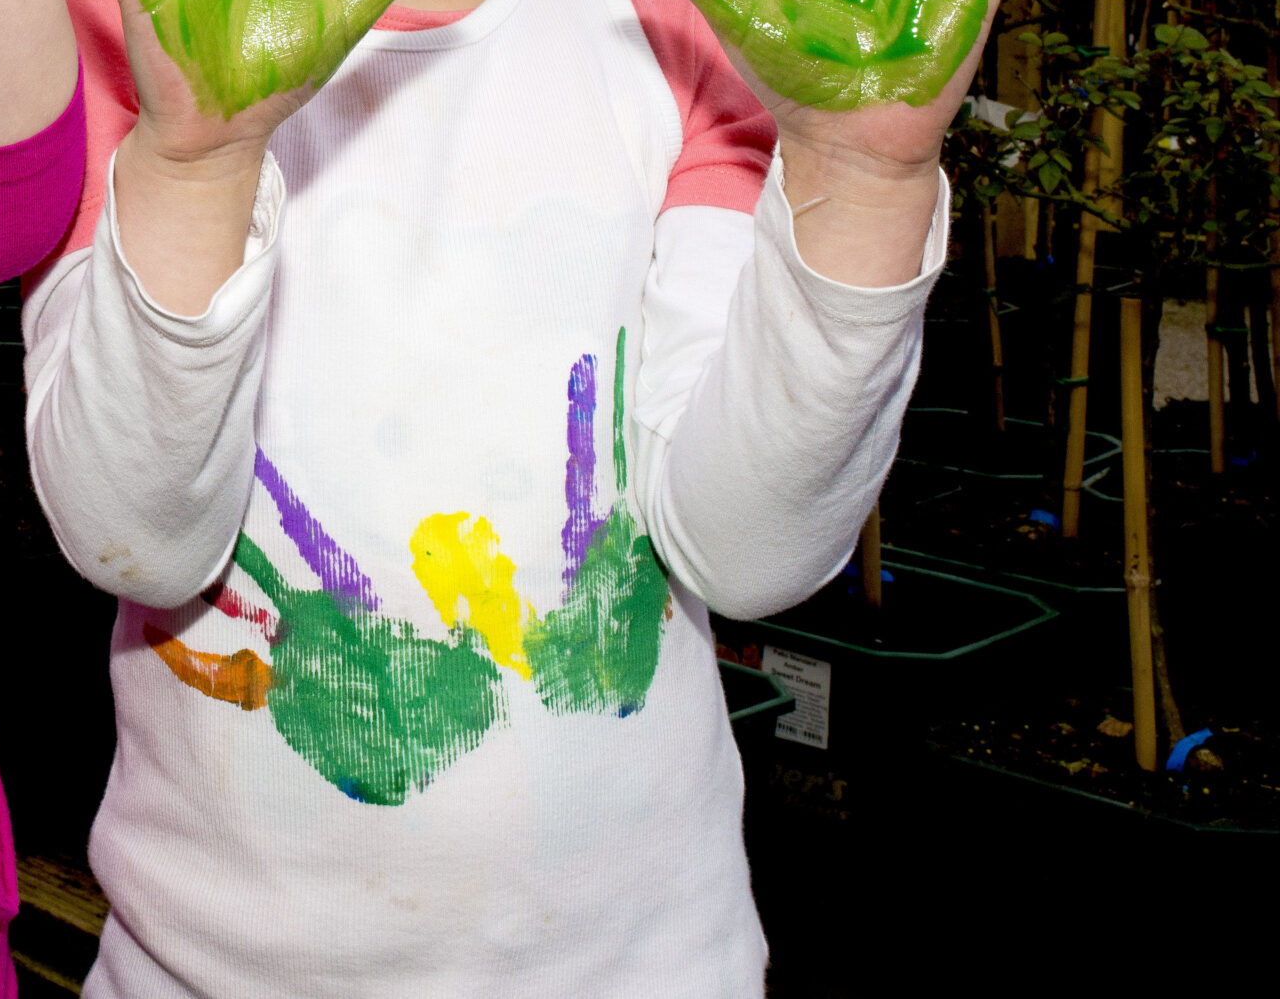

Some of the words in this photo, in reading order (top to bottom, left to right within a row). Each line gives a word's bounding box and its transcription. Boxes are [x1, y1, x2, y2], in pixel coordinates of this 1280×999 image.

[784, 662, 804, 672] Amber
[771, 667, 794, 681] Sweet
[795, 675, 822, 689] Dream
